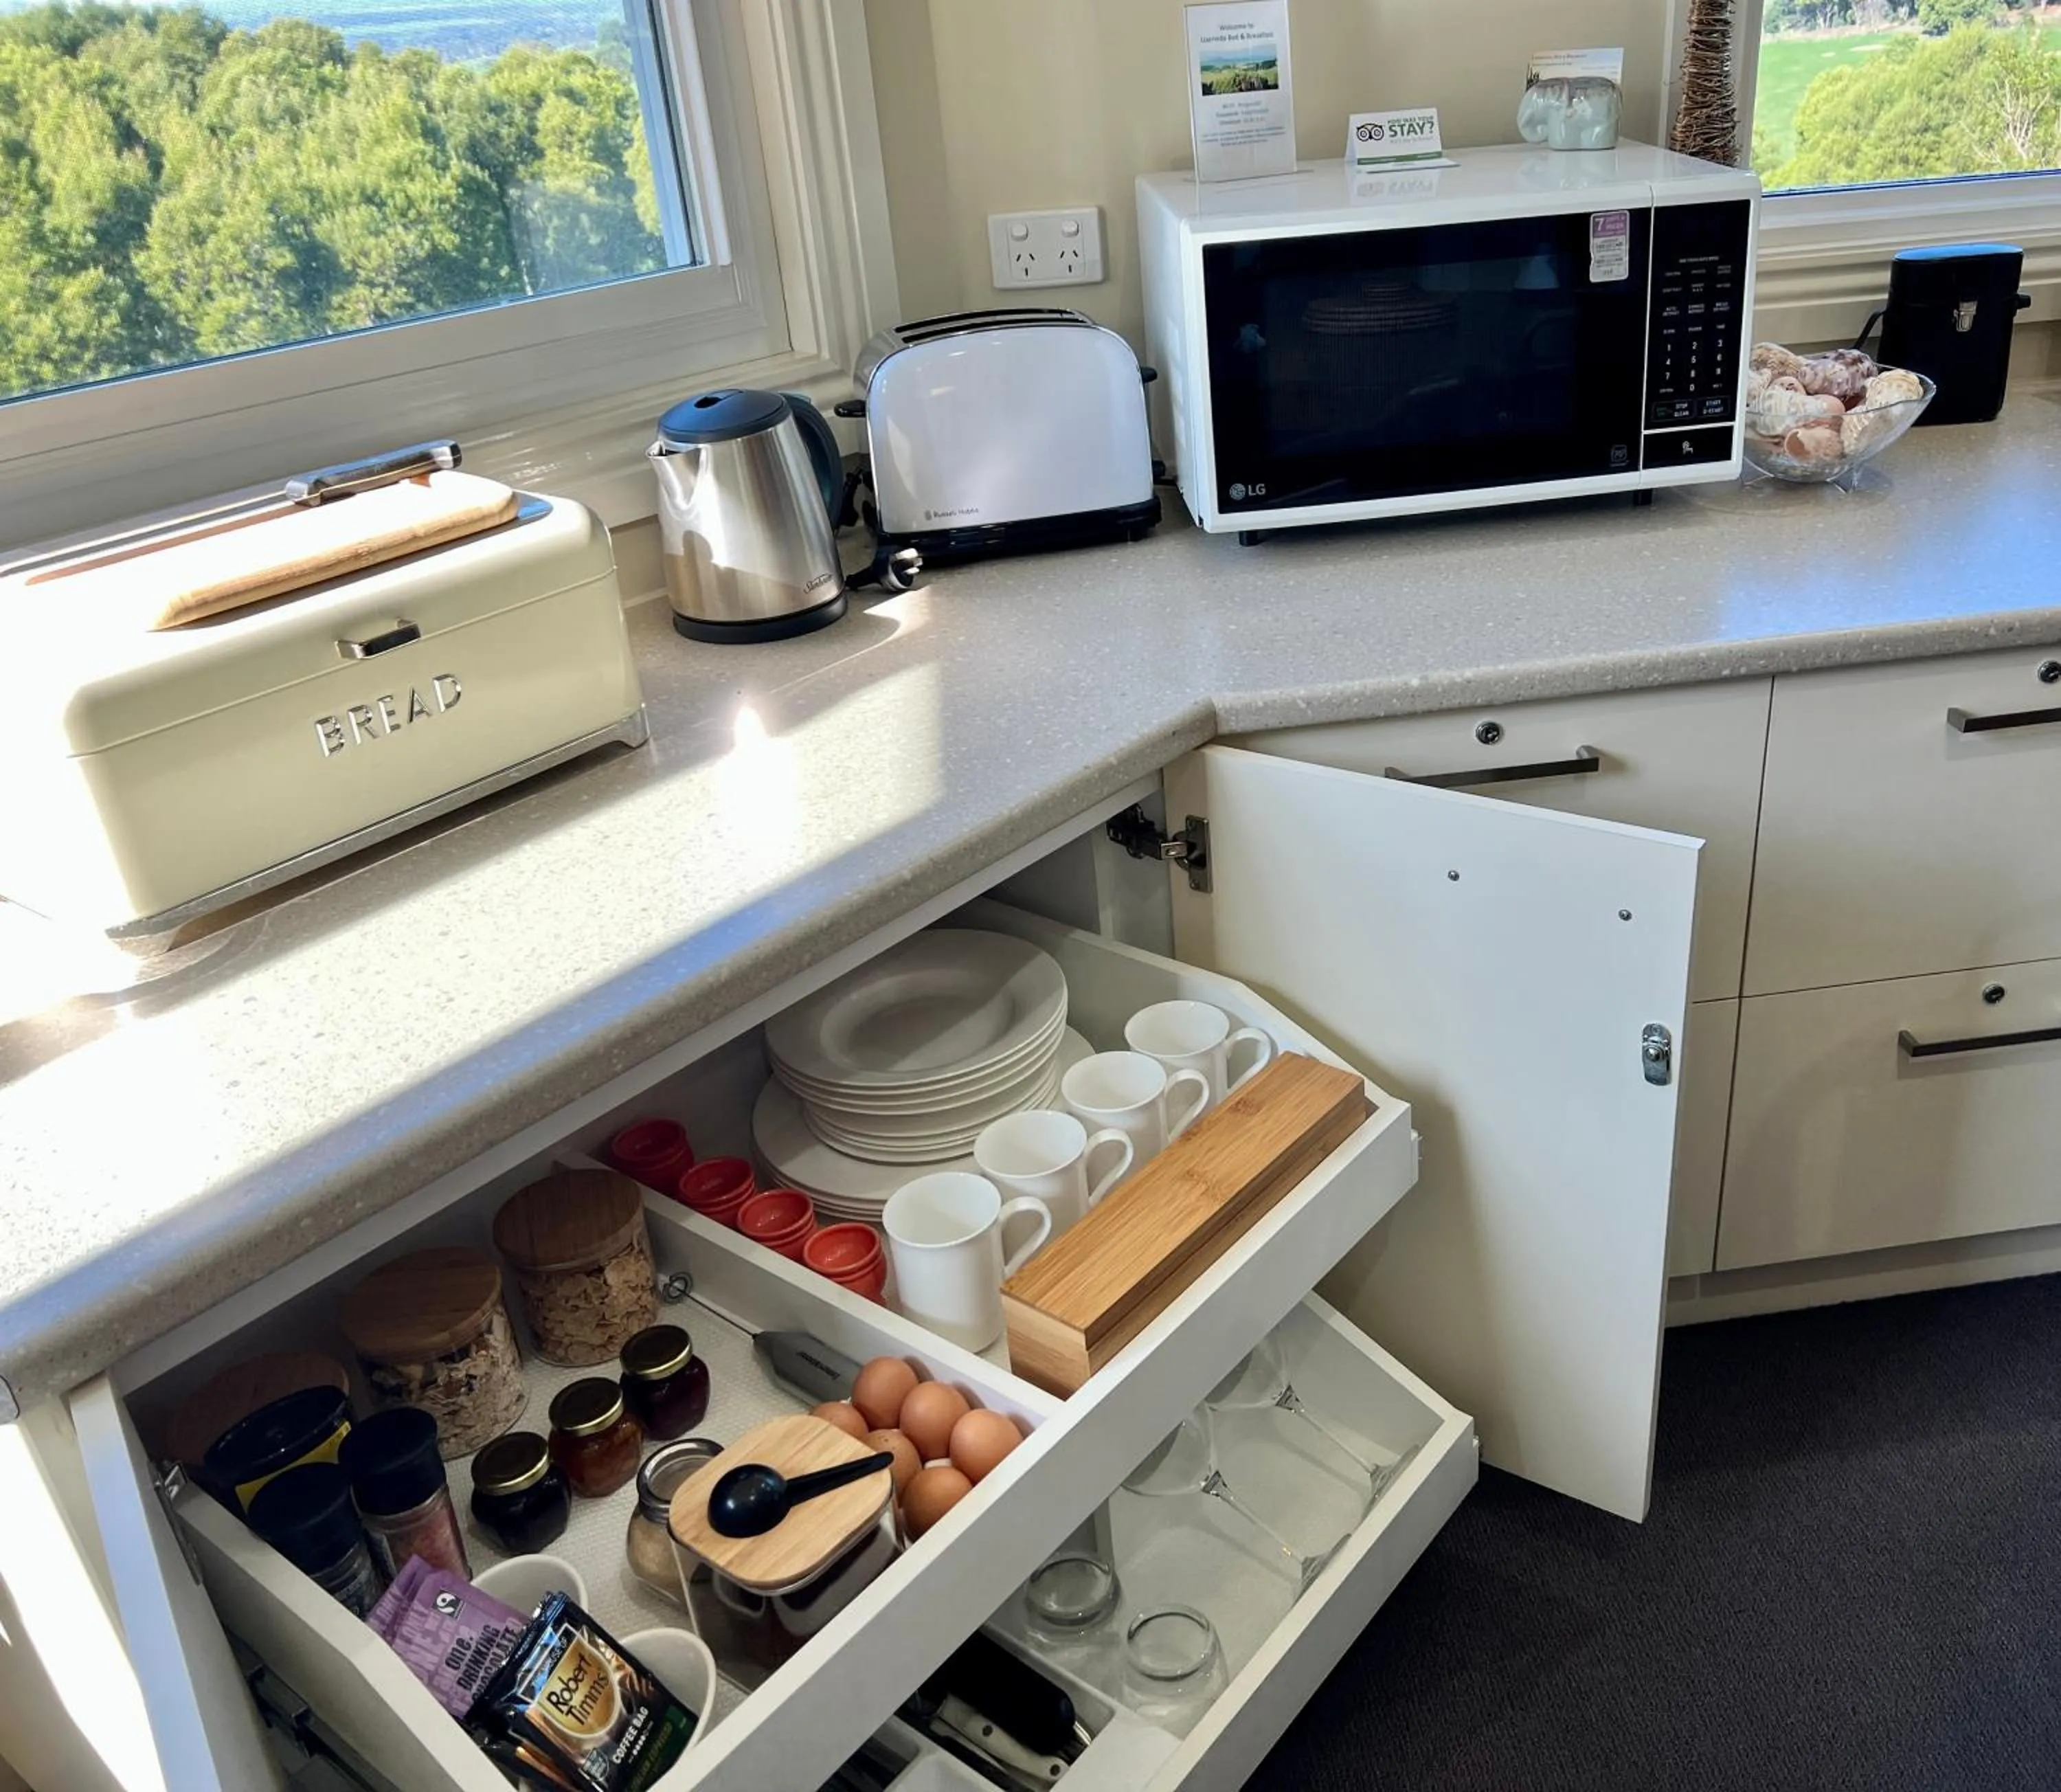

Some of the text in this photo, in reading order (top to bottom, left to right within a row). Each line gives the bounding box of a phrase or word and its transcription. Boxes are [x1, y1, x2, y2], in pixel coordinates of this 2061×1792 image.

[1388, 120, 1434, 138] STAY?
[1595, 218, 1604, 232] 7
[1248, 483, 1266, 495] LG
[315, 673, 462, 757] BREAD
[444, 1635, 475, 1672] one.
[457, 1624, 501, 1691] DRINKING
[547, 1653, 592, 1714] Robert
[565, 1672, 609, 1726] Timms
[612, 1725, 638, 1765] COFFEE
[632, 1706, 649, 1731] BAG
